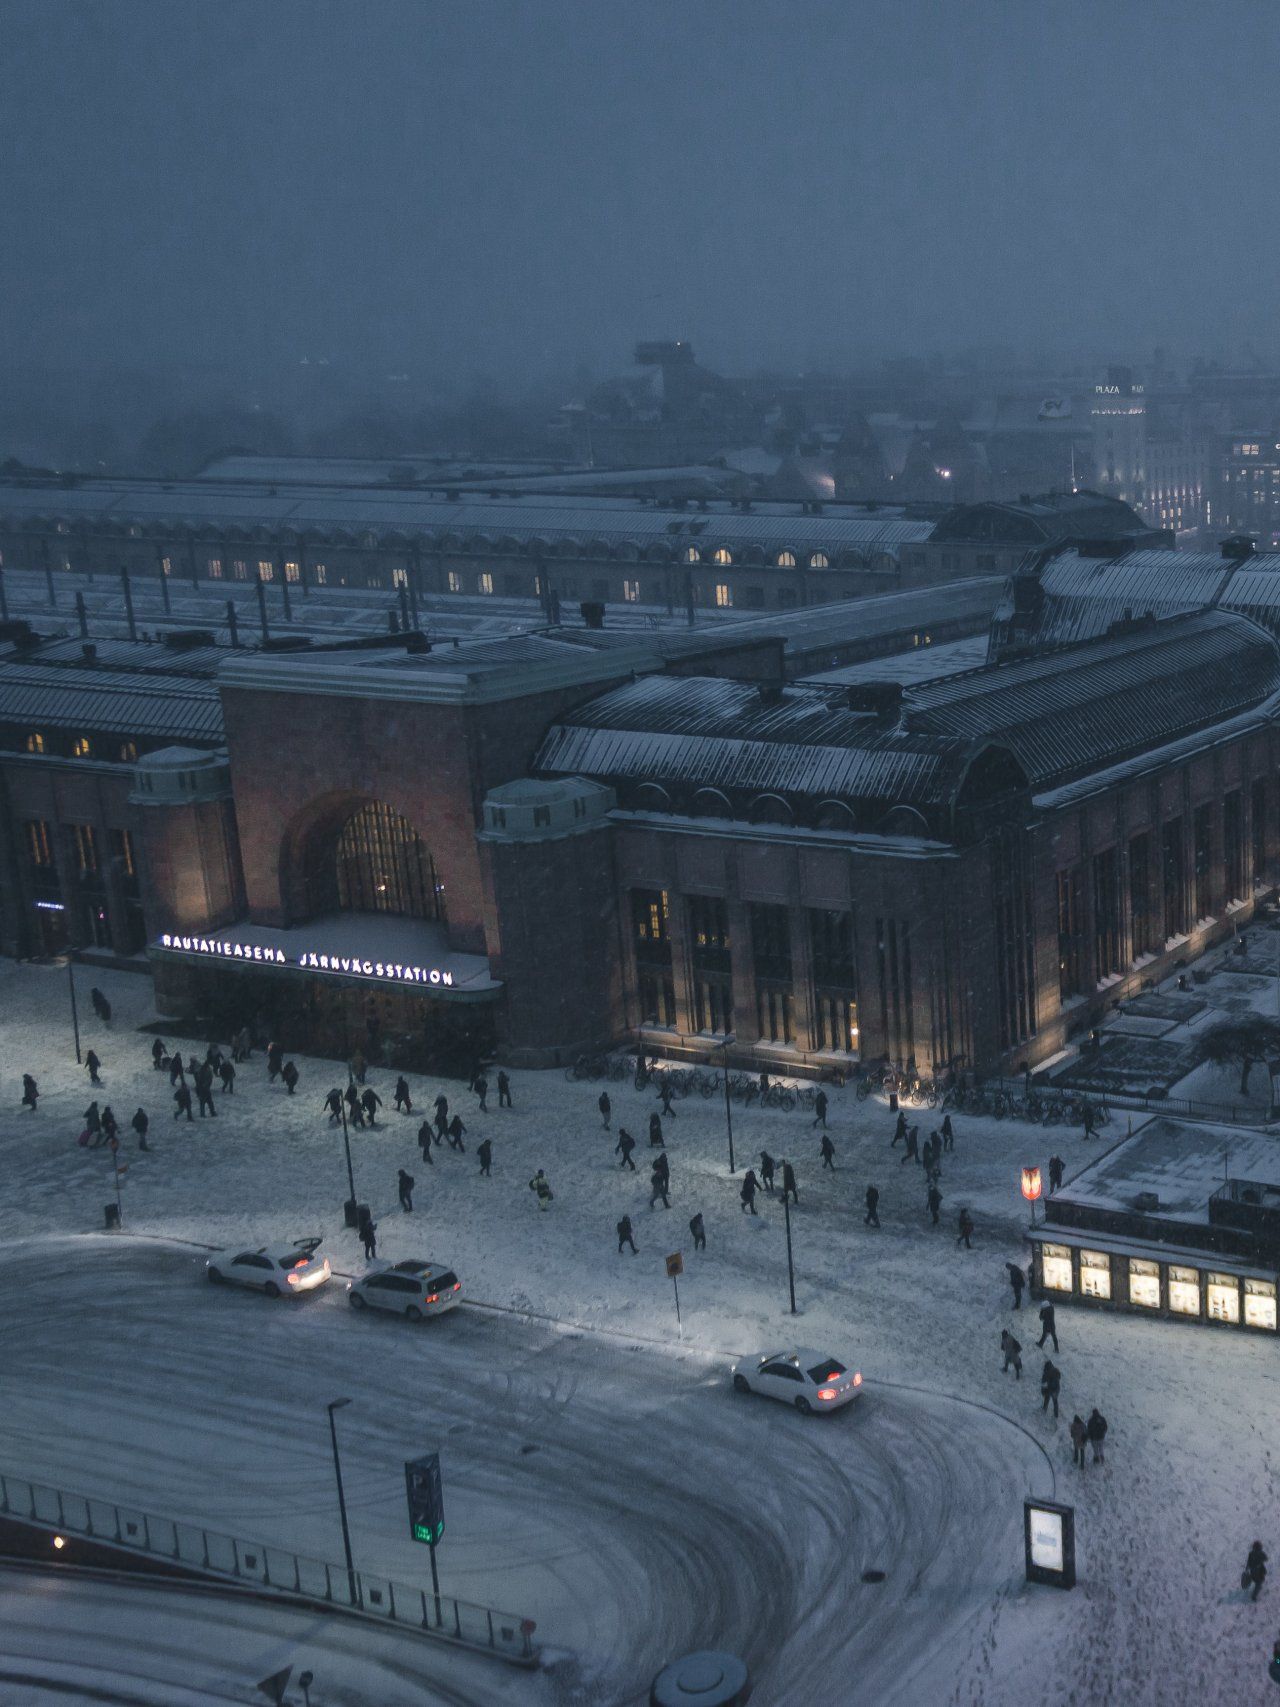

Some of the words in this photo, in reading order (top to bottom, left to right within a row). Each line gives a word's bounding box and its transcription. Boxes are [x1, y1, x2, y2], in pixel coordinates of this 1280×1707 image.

[1095, 385, 1120, 395] PLAZA
[161, 934, 286, 963] RAUTATIEASEMA
[299, 952, 454, 986] JÄRNVÄGSSTATION
